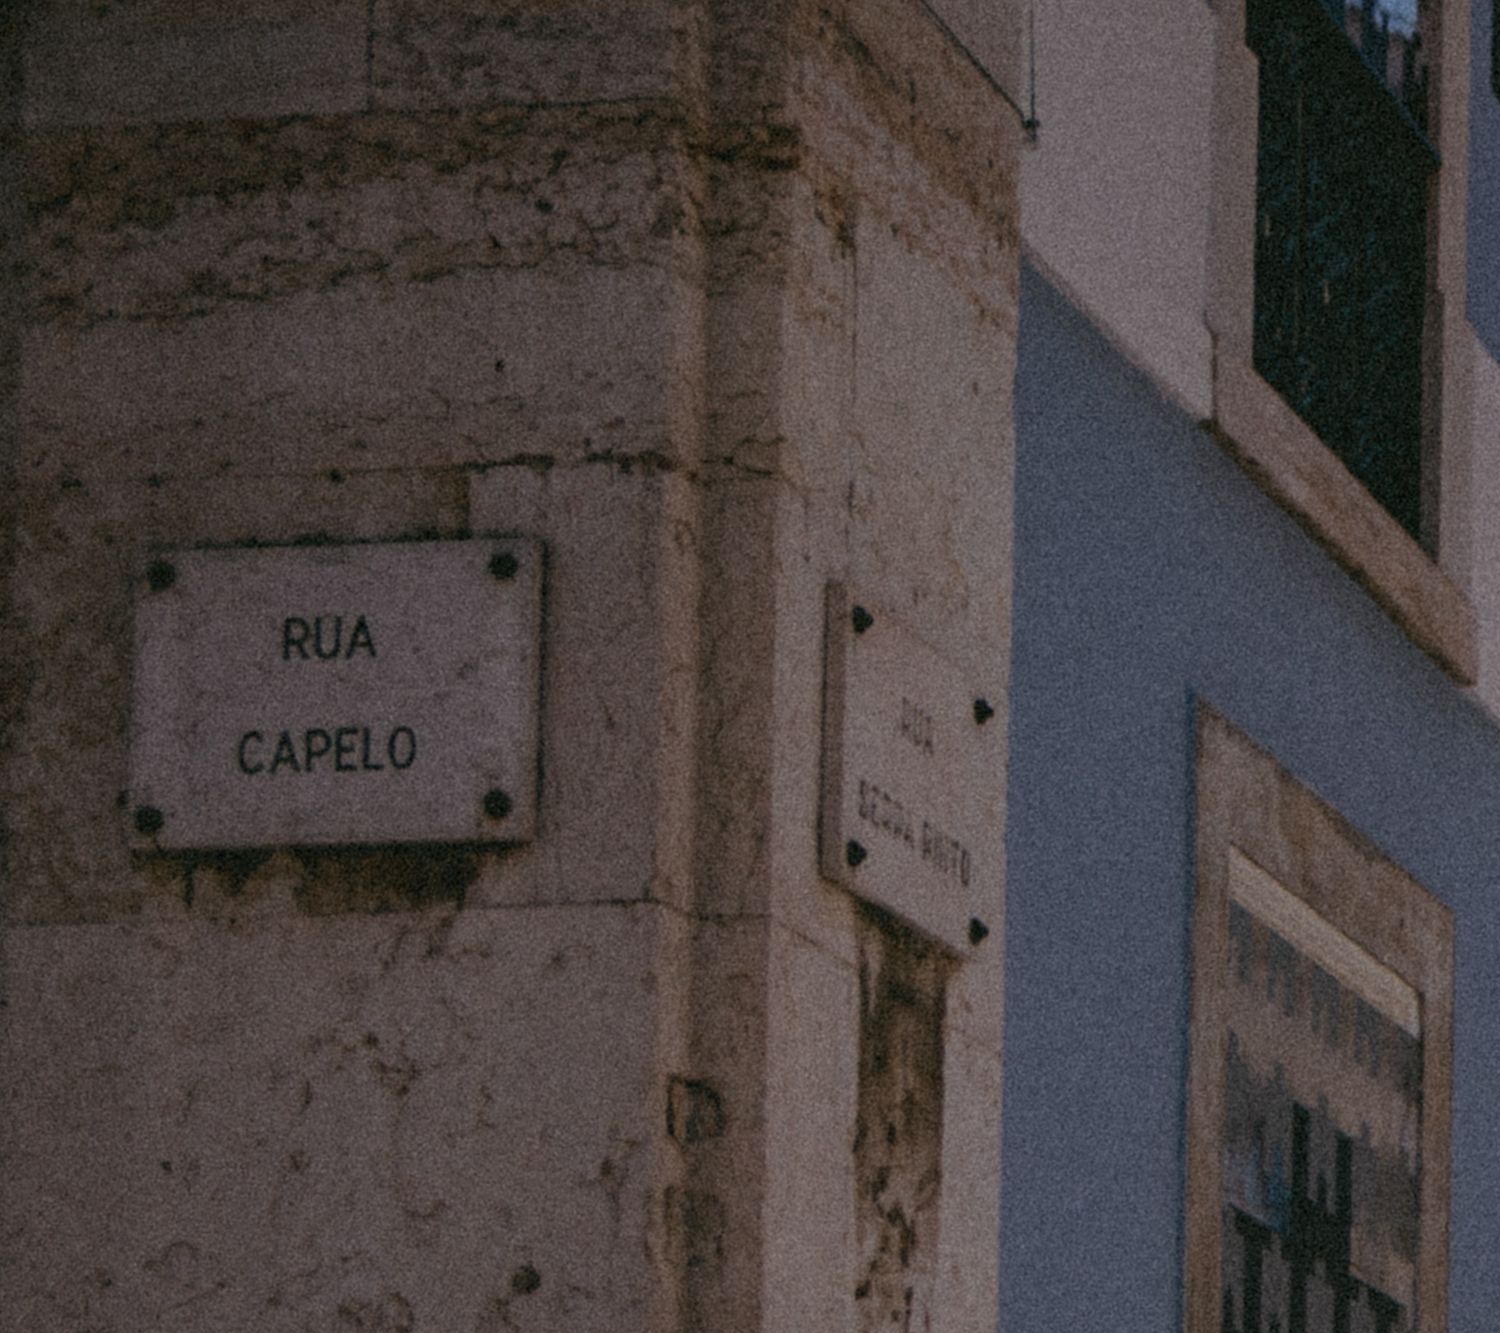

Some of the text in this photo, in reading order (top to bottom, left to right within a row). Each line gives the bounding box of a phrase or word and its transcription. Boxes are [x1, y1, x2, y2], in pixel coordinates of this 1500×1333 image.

[281, 614, 378, 661] RUA
[237, 725, 418, 775] CAPELO
[901, 697, 934, 756] RUA
